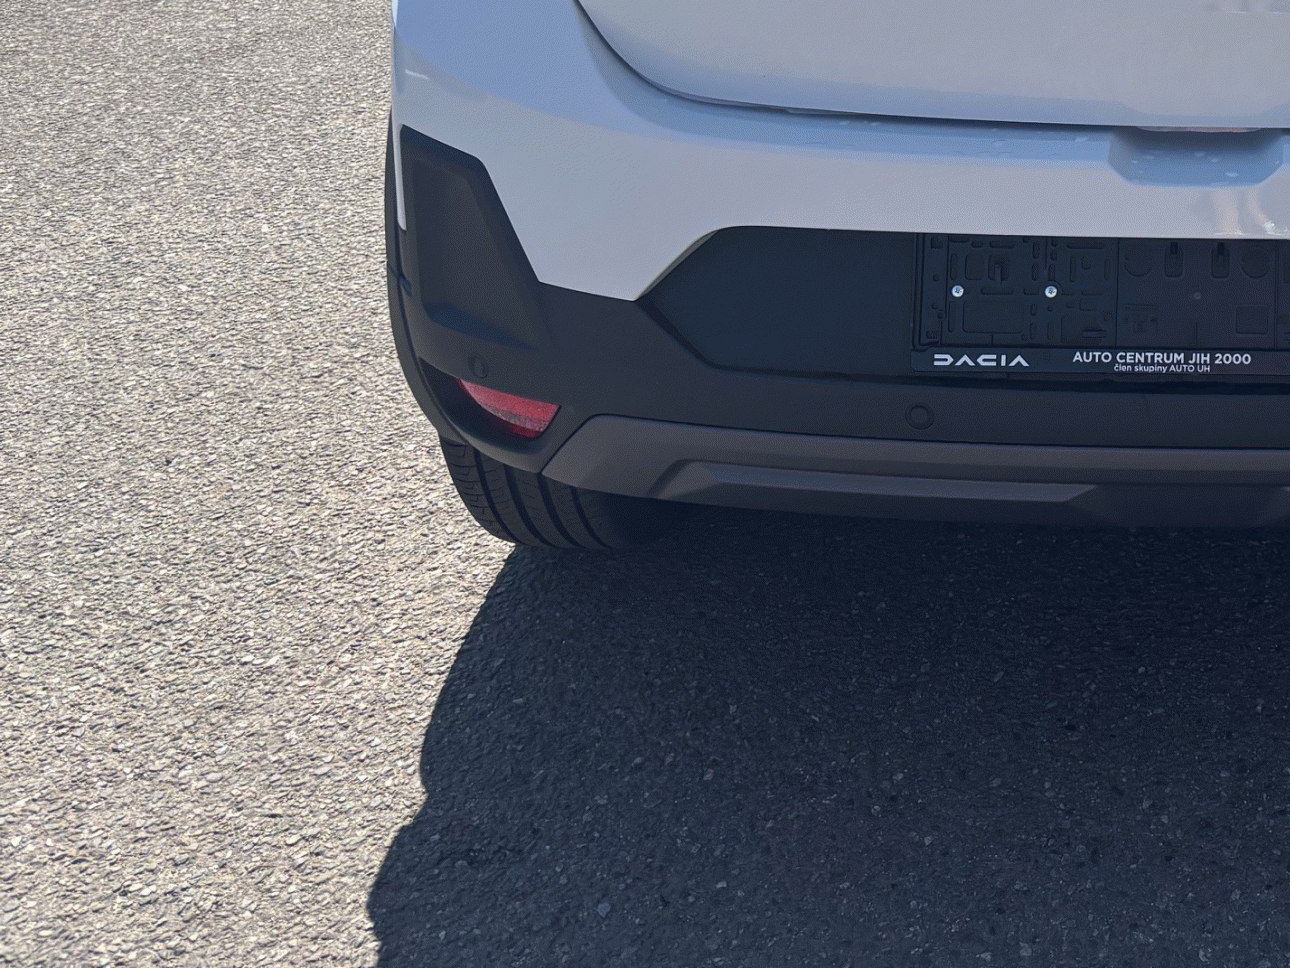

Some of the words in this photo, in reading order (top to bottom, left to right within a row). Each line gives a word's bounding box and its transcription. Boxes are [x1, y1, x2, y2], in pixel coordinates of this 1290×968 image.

[933, 353, 1030, 367] DACIA
[1072, 351, 1112, 363] AUTO
[1116, 352, 1184, 364] CENTRUM
[1188, 353, 1210, 365] JIH
[1214, 353, 1251, 365] 2000
[1113, 363, 1132, 372] člen
[1134, 364, 1168, 374] skupiny
[1169, 364, 1195, 373] AUTO
[1197, 365, 1211, 373] UH
